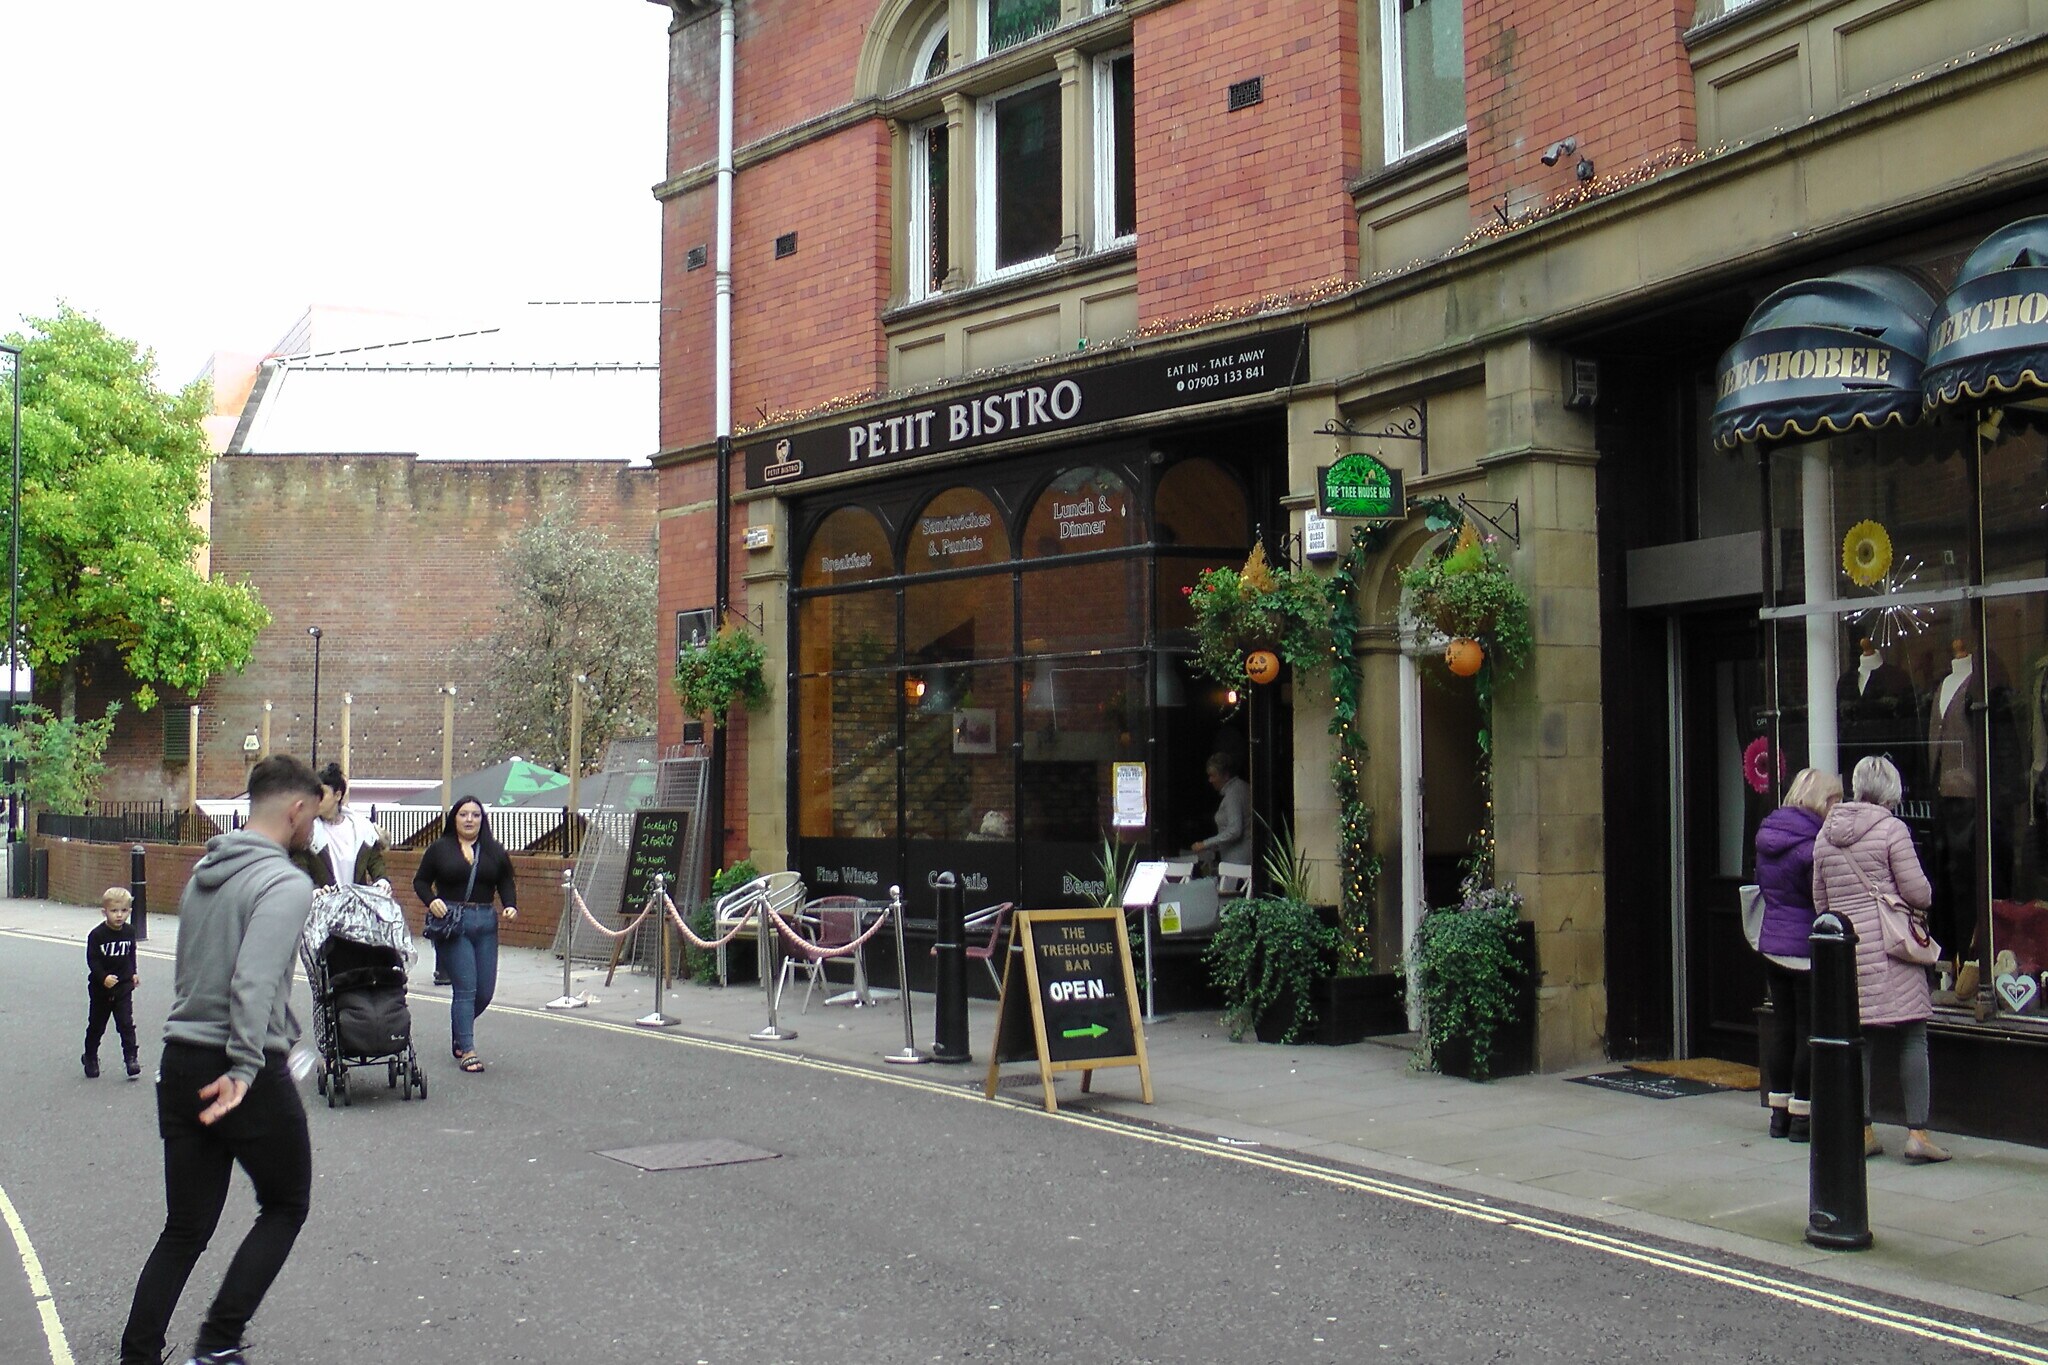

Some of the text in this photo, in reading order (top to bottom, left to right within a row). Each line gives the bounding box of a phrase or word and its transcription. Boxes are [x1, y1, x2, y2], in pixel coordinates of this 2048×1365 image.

[1928, 292, 2048, 357] EECHO
[1167, 364, 1184, 378] EAT
[1187, 362, 1199, 375] IN
[1209, 355, 1234, 369] TAKE
[1238, 348, 1265, 364] AWAY
[1719, 347, 1891, 397] EECHOBEE
[1187, 364, 1265, 391] 07903 133 841
[849, 379, 1082, 462] PETIT BISTRO
[1327, 485, 1391, 499] THE TREE HOUSE BAR
[1053, 495, 1112, 520] Lunch &
[922, 512, 991, 535] Sandwiches
[1060, 520, 1106, 539] Dinner
[928, 534, 984, 557] & Paninis
[821, 552, 873, 573] Breakfast
[816, 866, 879, 885] Fine Wines
[928, 870, 989, 890] Cails
[1063, 875, 1105, 895] Beers
[1061, 926, 1086, 939] THE
[1040, 941, 1114, 957] TREEHOUSE
[1065, 959, 1092, 972] BAR
